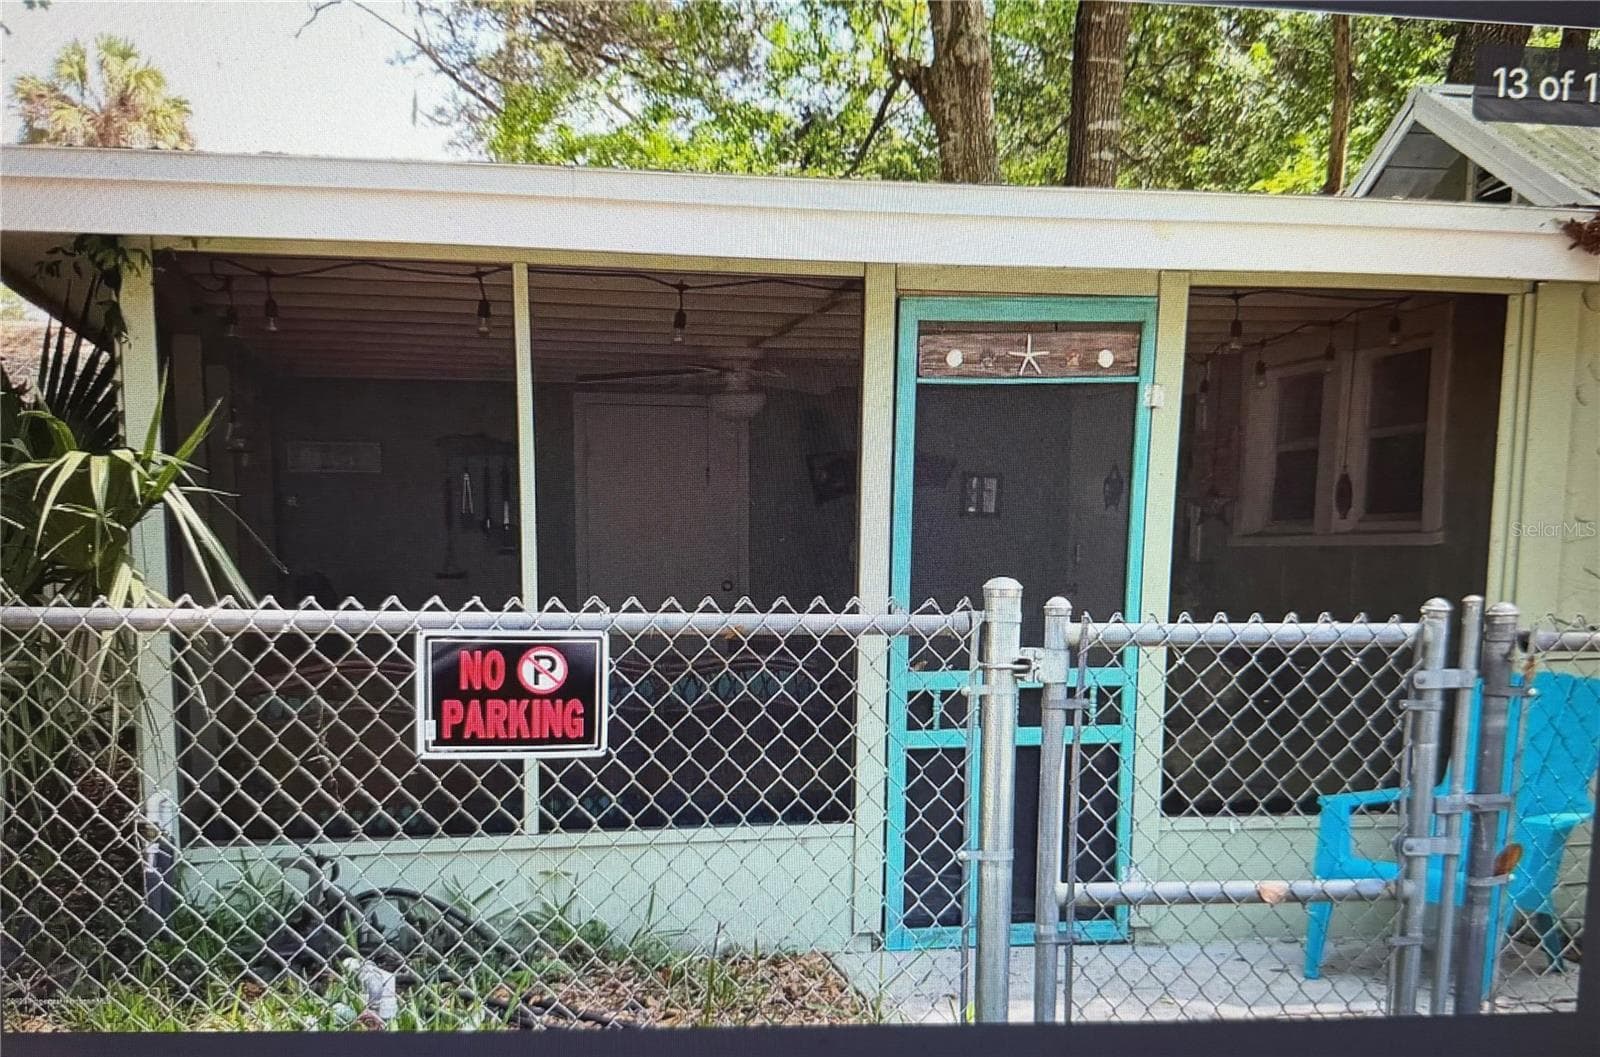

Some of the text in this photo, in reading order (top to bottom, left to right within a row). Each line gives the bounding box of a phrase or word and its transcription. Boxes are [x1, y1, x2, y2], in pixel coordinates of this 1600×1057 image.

[1492, 66, 1600, 103] 13 of 1
[458, 649, 506, 691] NO
[441, 698, 586, 740] PARKING
